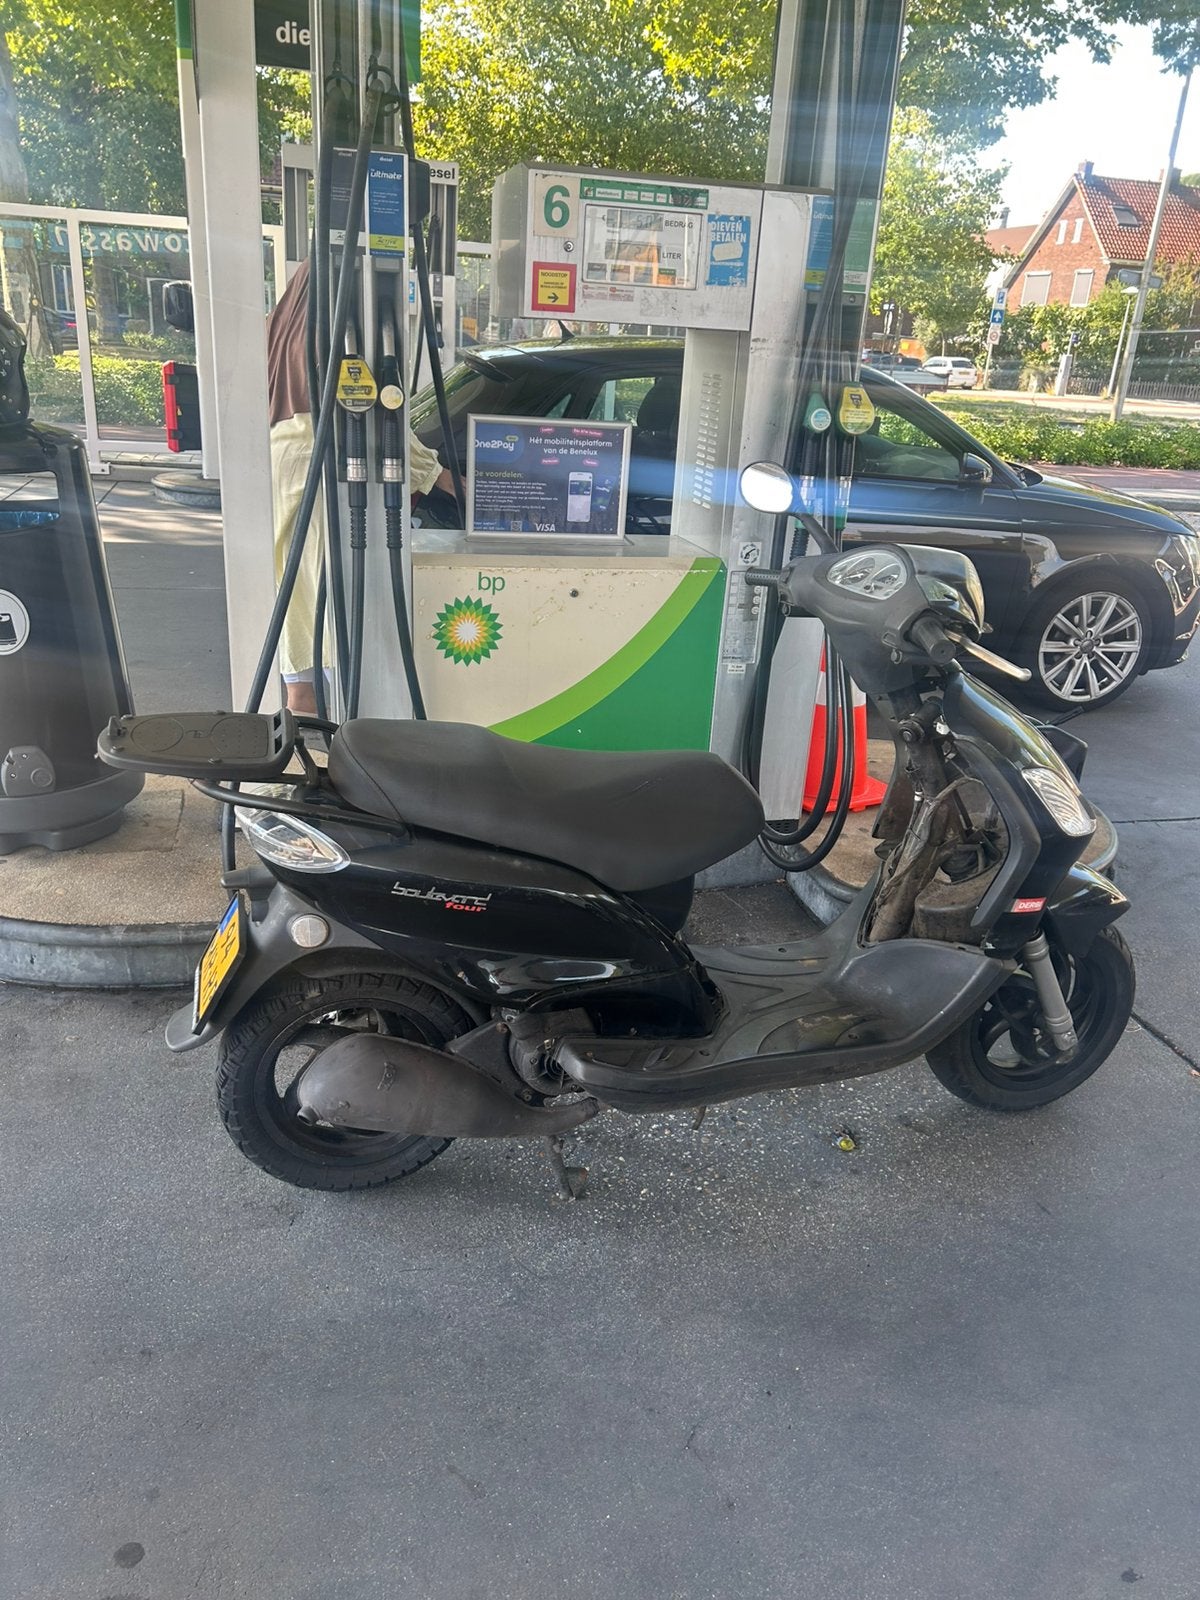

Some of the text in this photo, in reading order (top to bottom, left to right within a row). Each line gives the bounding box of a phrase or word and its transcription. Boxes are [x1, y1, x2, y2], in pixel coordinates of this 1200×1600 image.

[275, 21, 311, 46] die
[430, 168, 456, 180] esel
[543, 184, 570, 229] 6
[664, 219, 694, 229] BEDRAG
[711, 221, 743, 232] DIEVEN
[710, 232, 747, 243] BETALEN
[662, 252, 682, 260] LITER
[529, 436, 613, 448] Hét mobiliteitsplatform
[558, 447, 568, 455] de
[569, 447, 598, 456] Benelux
[535, 523, 556, 532] VISA
[477, 571, 506, 596] bp
[445, 901, 487, 912] four
